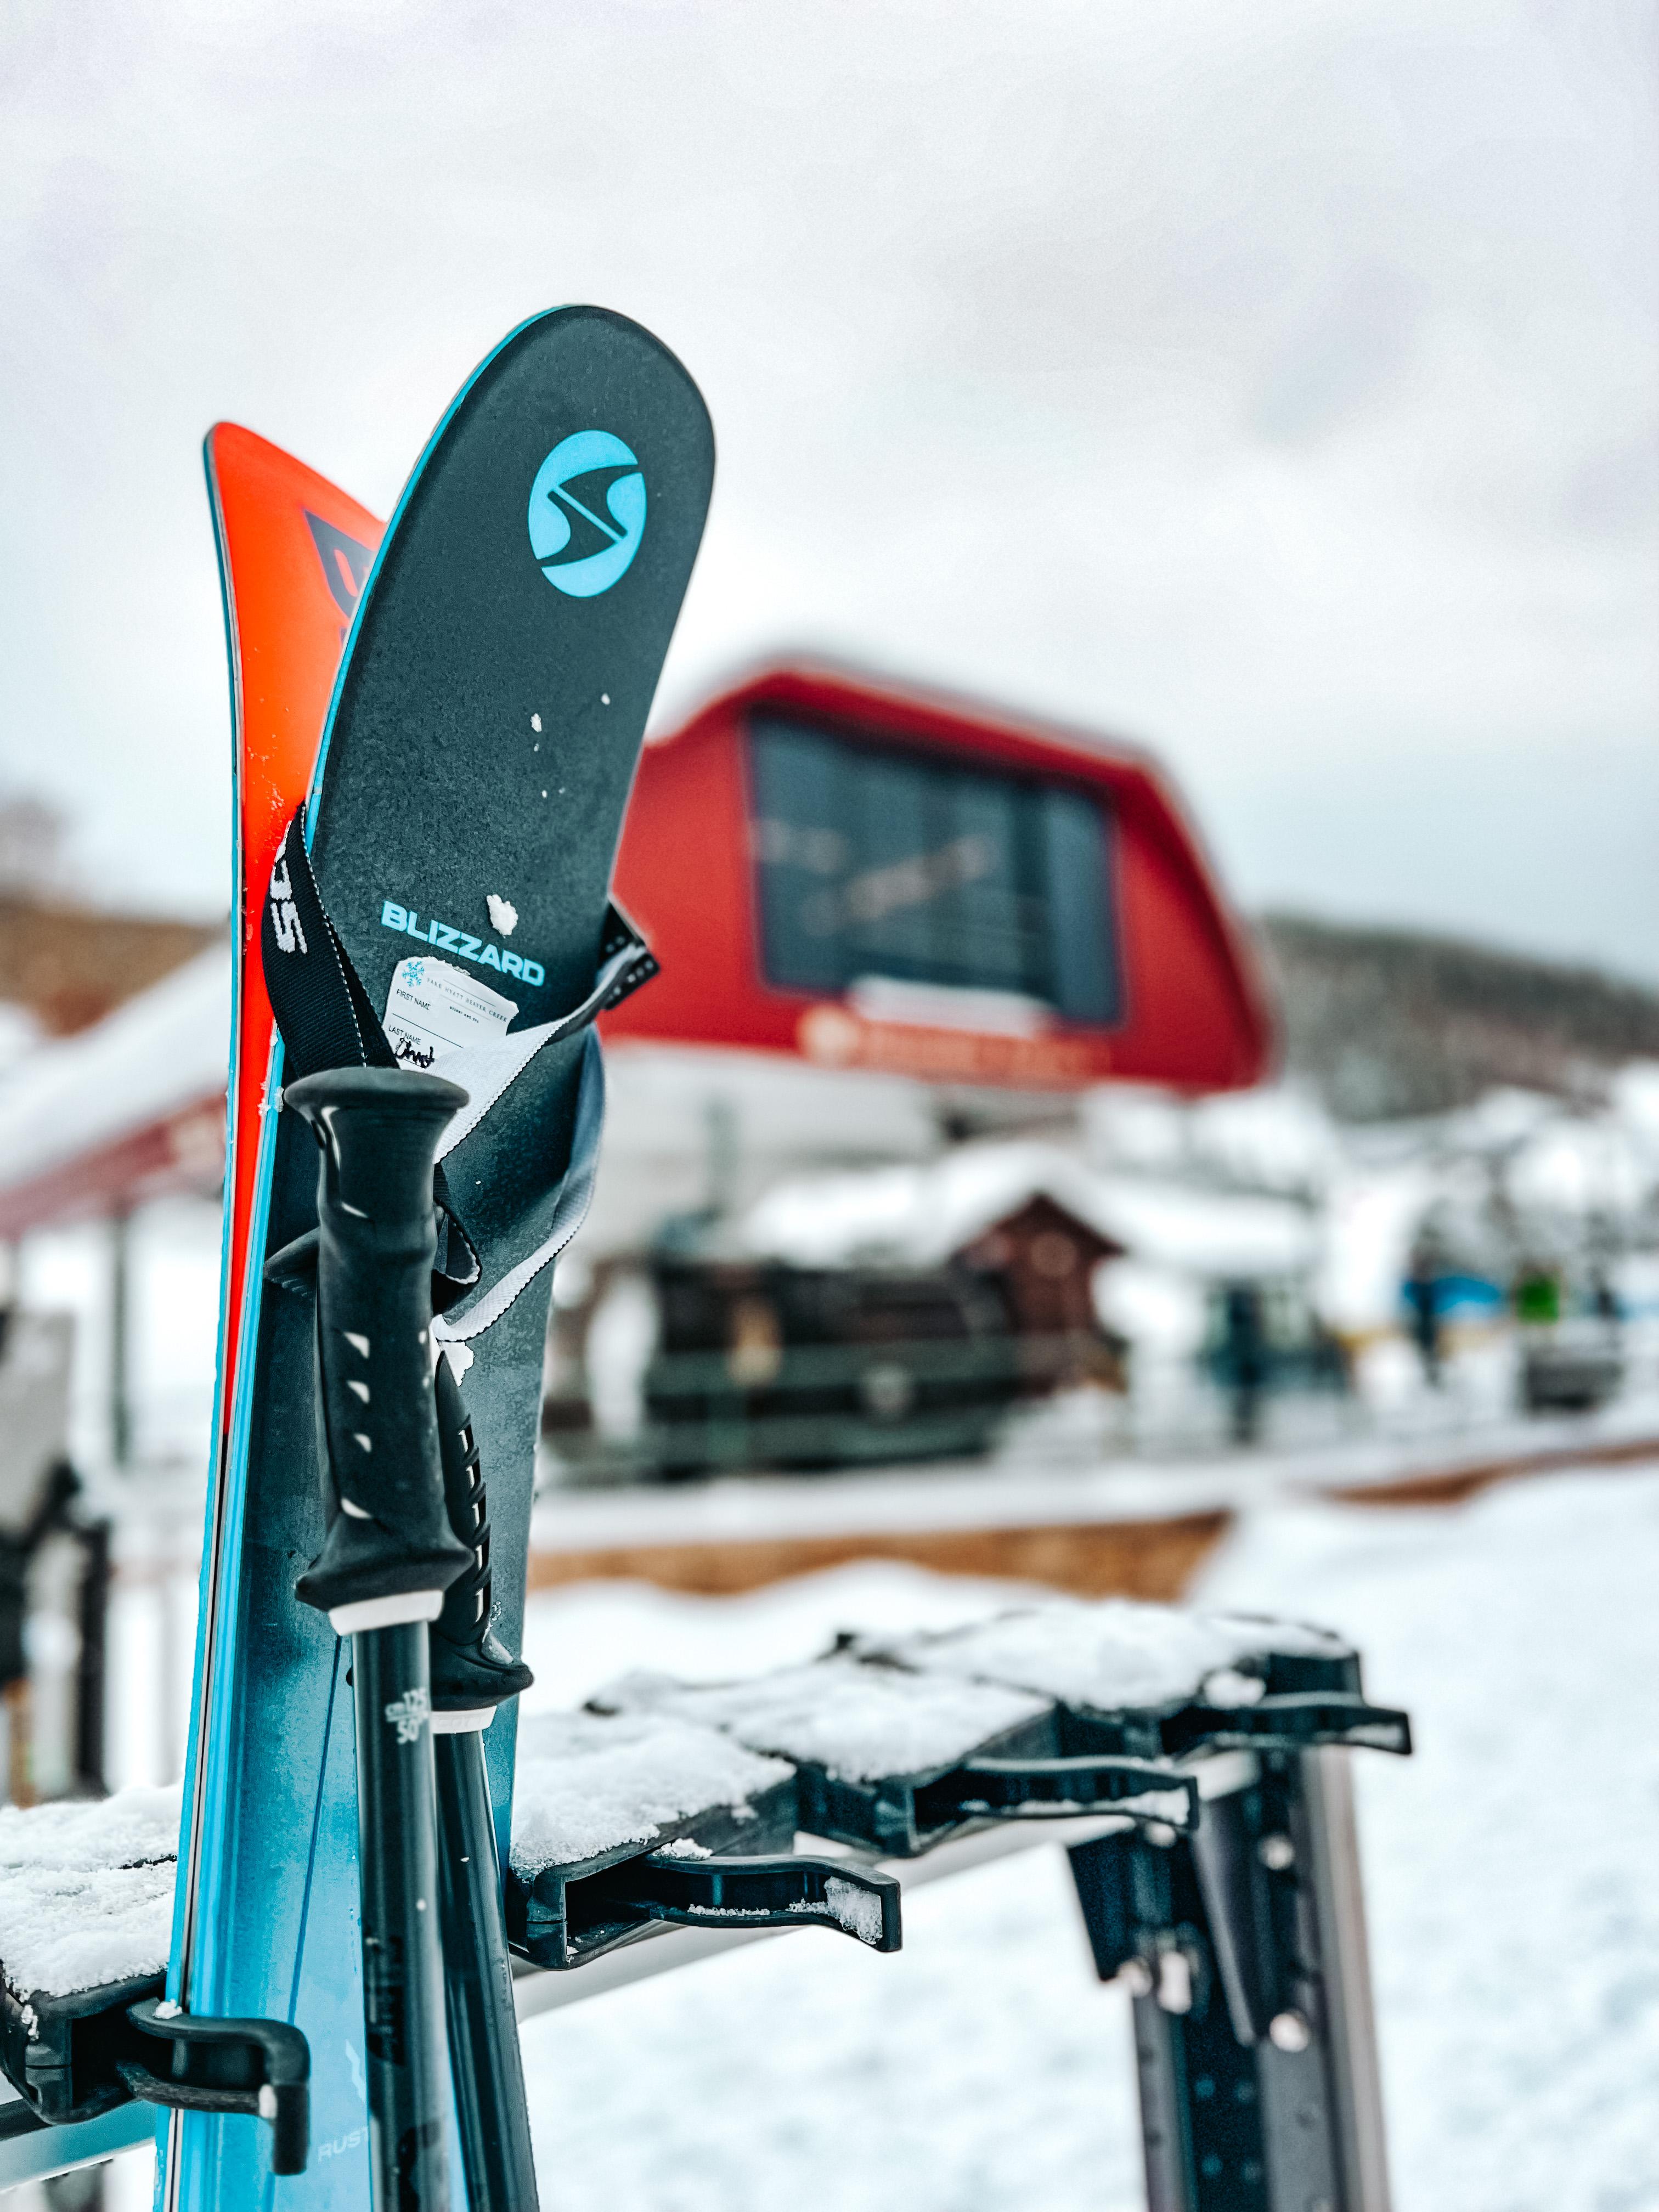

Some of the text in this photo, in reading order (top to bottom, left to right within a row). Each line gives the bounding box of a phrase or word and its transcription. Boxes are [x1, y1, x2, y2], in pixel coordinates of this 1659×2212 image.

[381, 900, 545, 986] BLIZZARD
[396, 989, 431, 1011] FIRST NAME
[445, 987, 464, 1000] HYATT
[466, 997, 486, 1012] BEAVER
[489, 1009, 508, 1023] CREEK
[388, 1025, 421, 1045] LAST NAME
